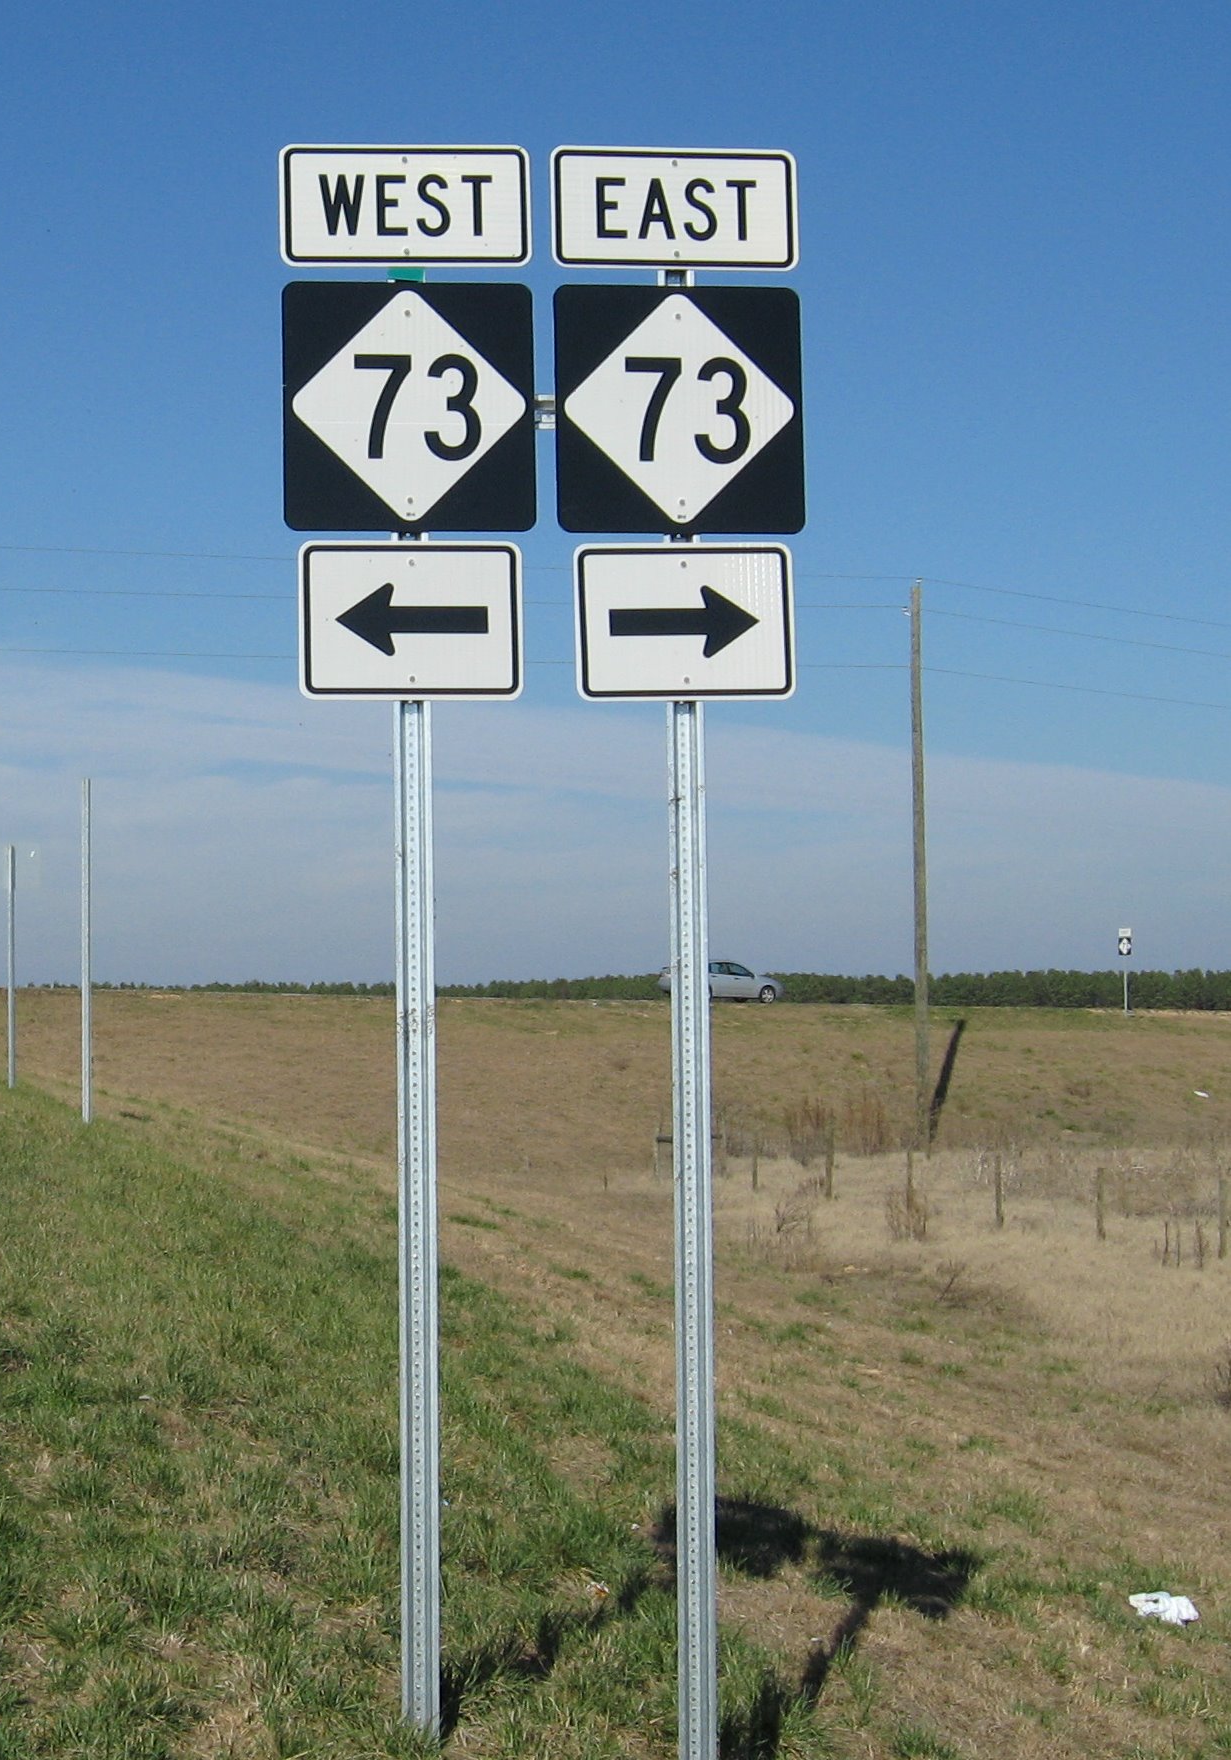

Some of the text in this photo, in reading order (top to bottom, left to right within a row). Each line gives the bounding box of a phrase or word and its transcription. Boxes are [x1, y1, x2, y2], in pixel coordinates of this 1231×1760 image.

[319, 174, 492, 237] WEST
[596, 177, 756, 241] EAST
[354, 354, 481, 461] 73
[625, 357, 750, 464] 73
